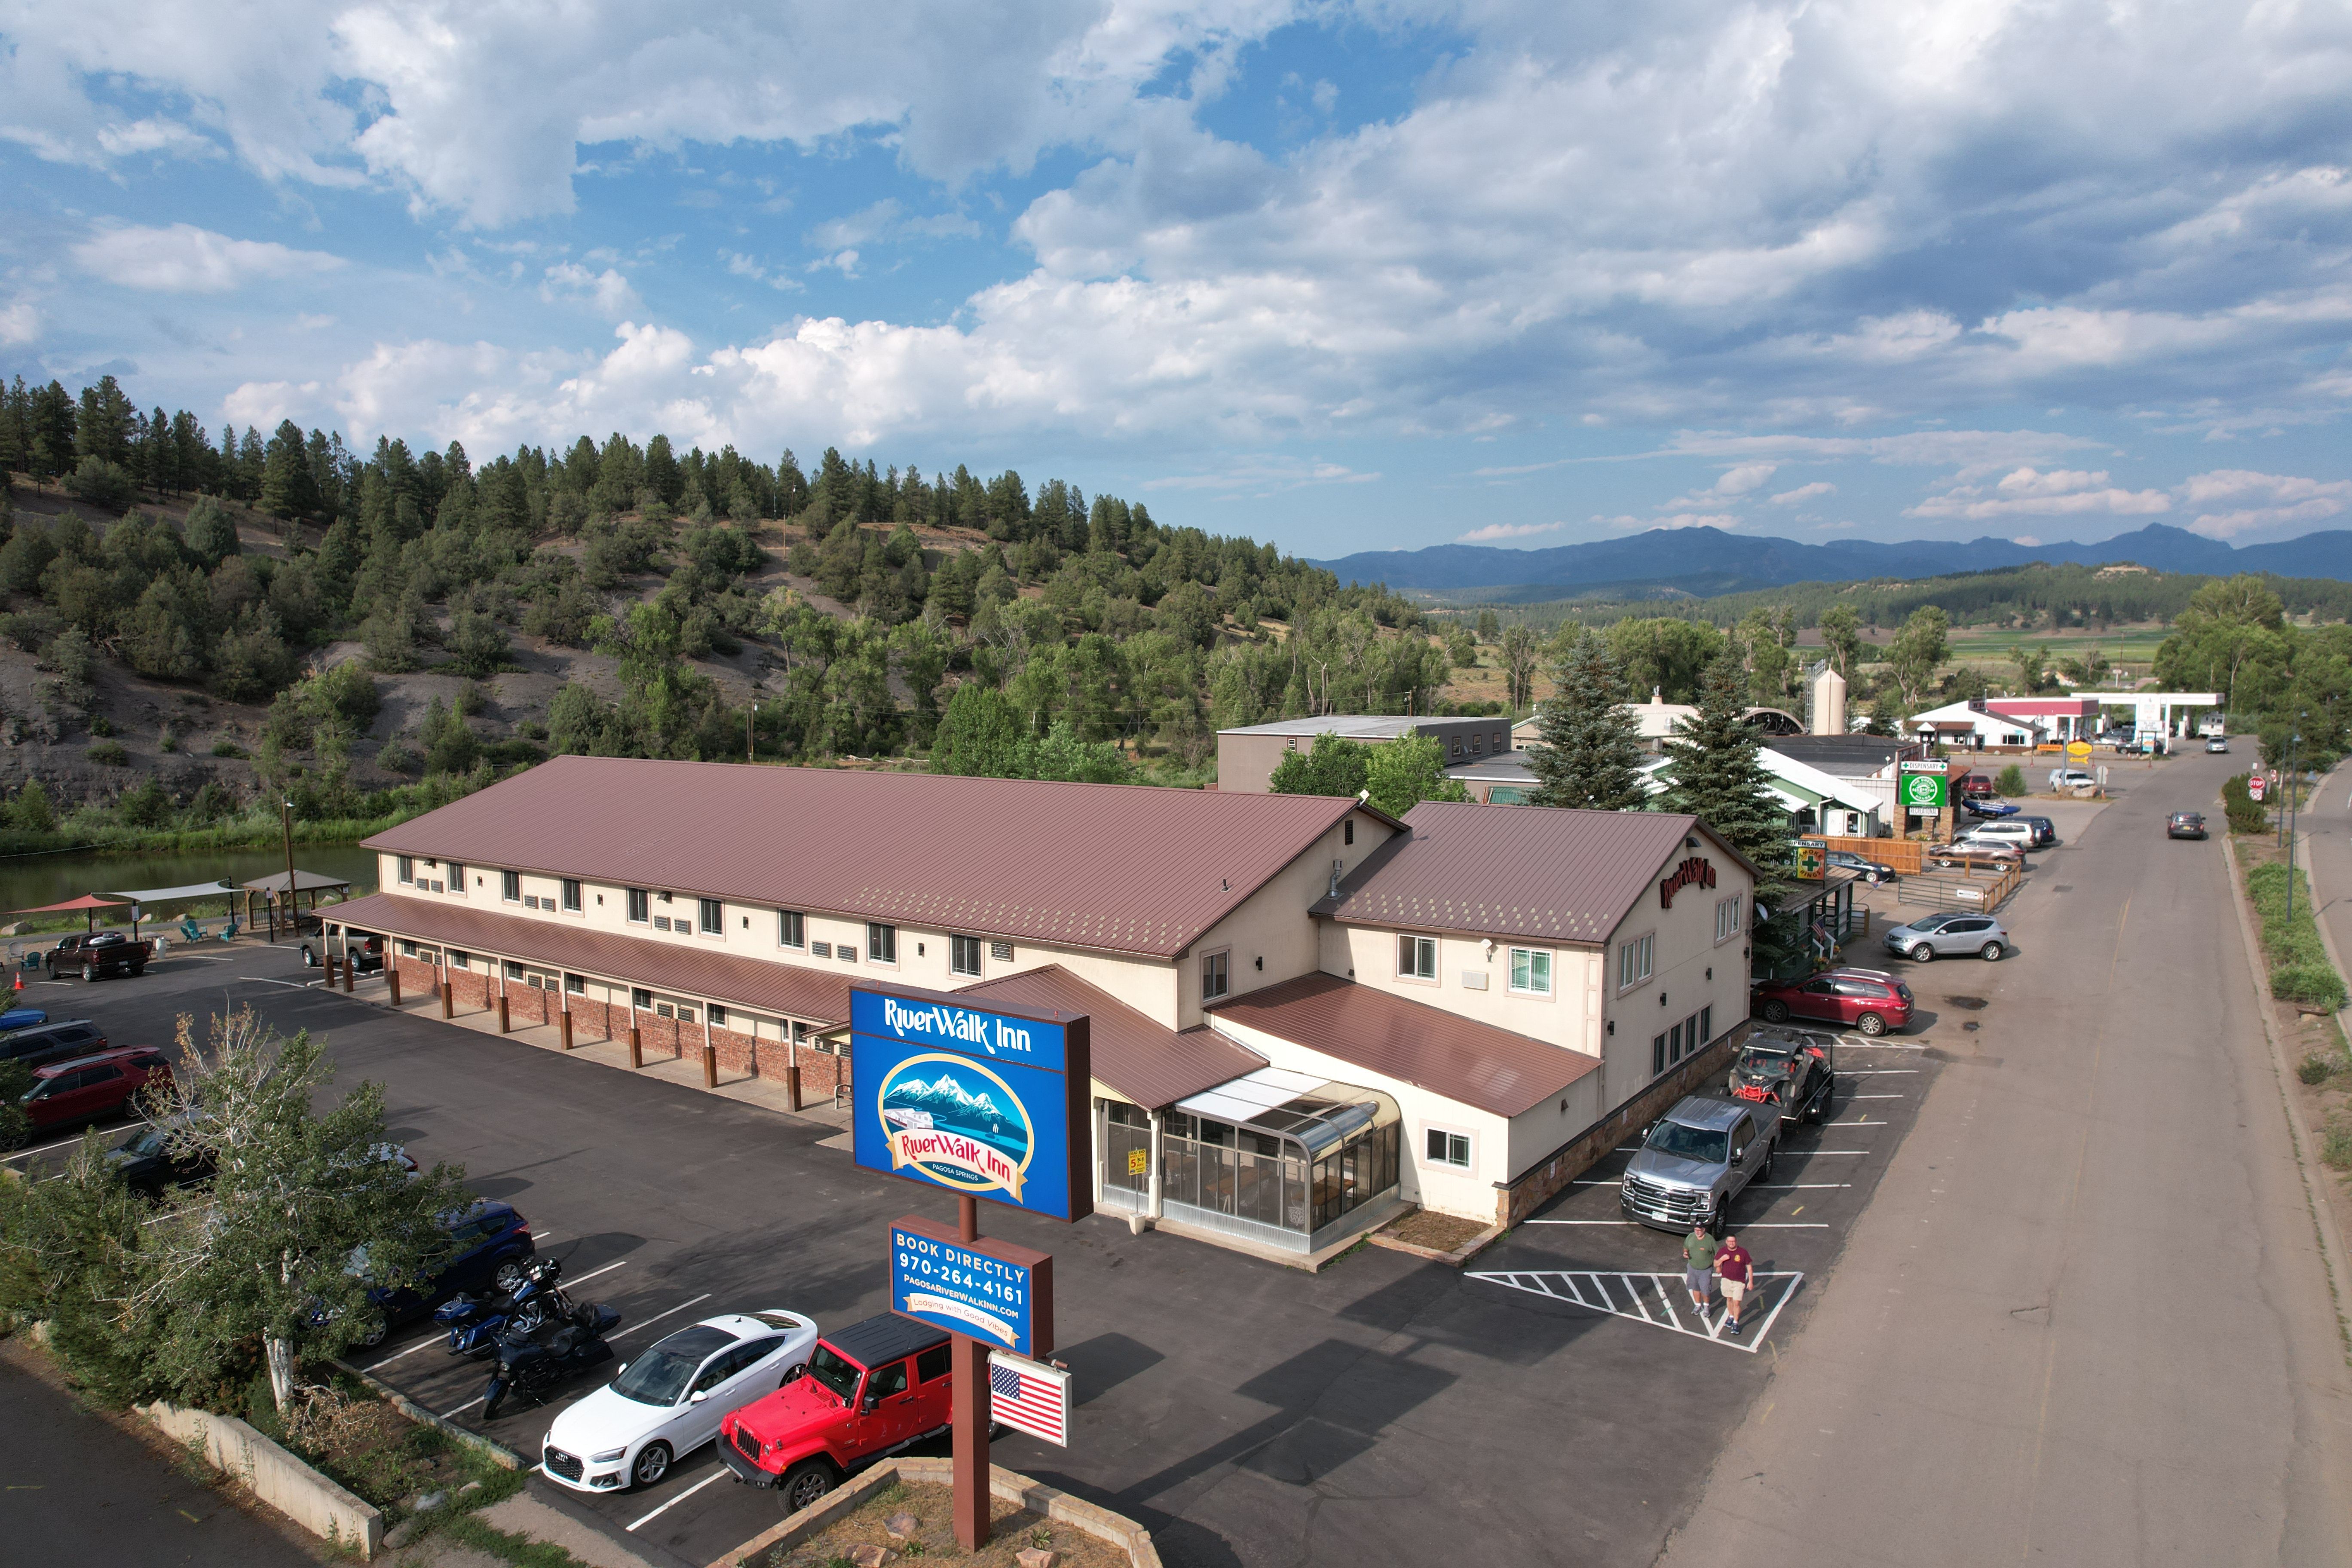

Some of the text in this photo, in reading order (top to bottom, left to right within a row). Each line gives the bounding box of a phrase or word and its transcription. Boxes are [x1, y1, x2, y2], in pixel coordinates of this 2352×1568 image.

[1798, 849, 1823, 859] SMOKE
[1800, 870, 1821, 878] RINGS
[997, 1019, 1032, 1052] Inn
[932, 1164, 978, 1181] PAGOSA SPRINGS
[987, 1153, 1011, 1182] Inn
[1131, 1159, 1136, 1168] 5
[897, 1233, 1024, 1283] BOOK DIRECTLY
[899, 1253, 1022, 1305] 970-264-4161
[913, 1298, 1008, 1337] Lodging with Good Vibes
